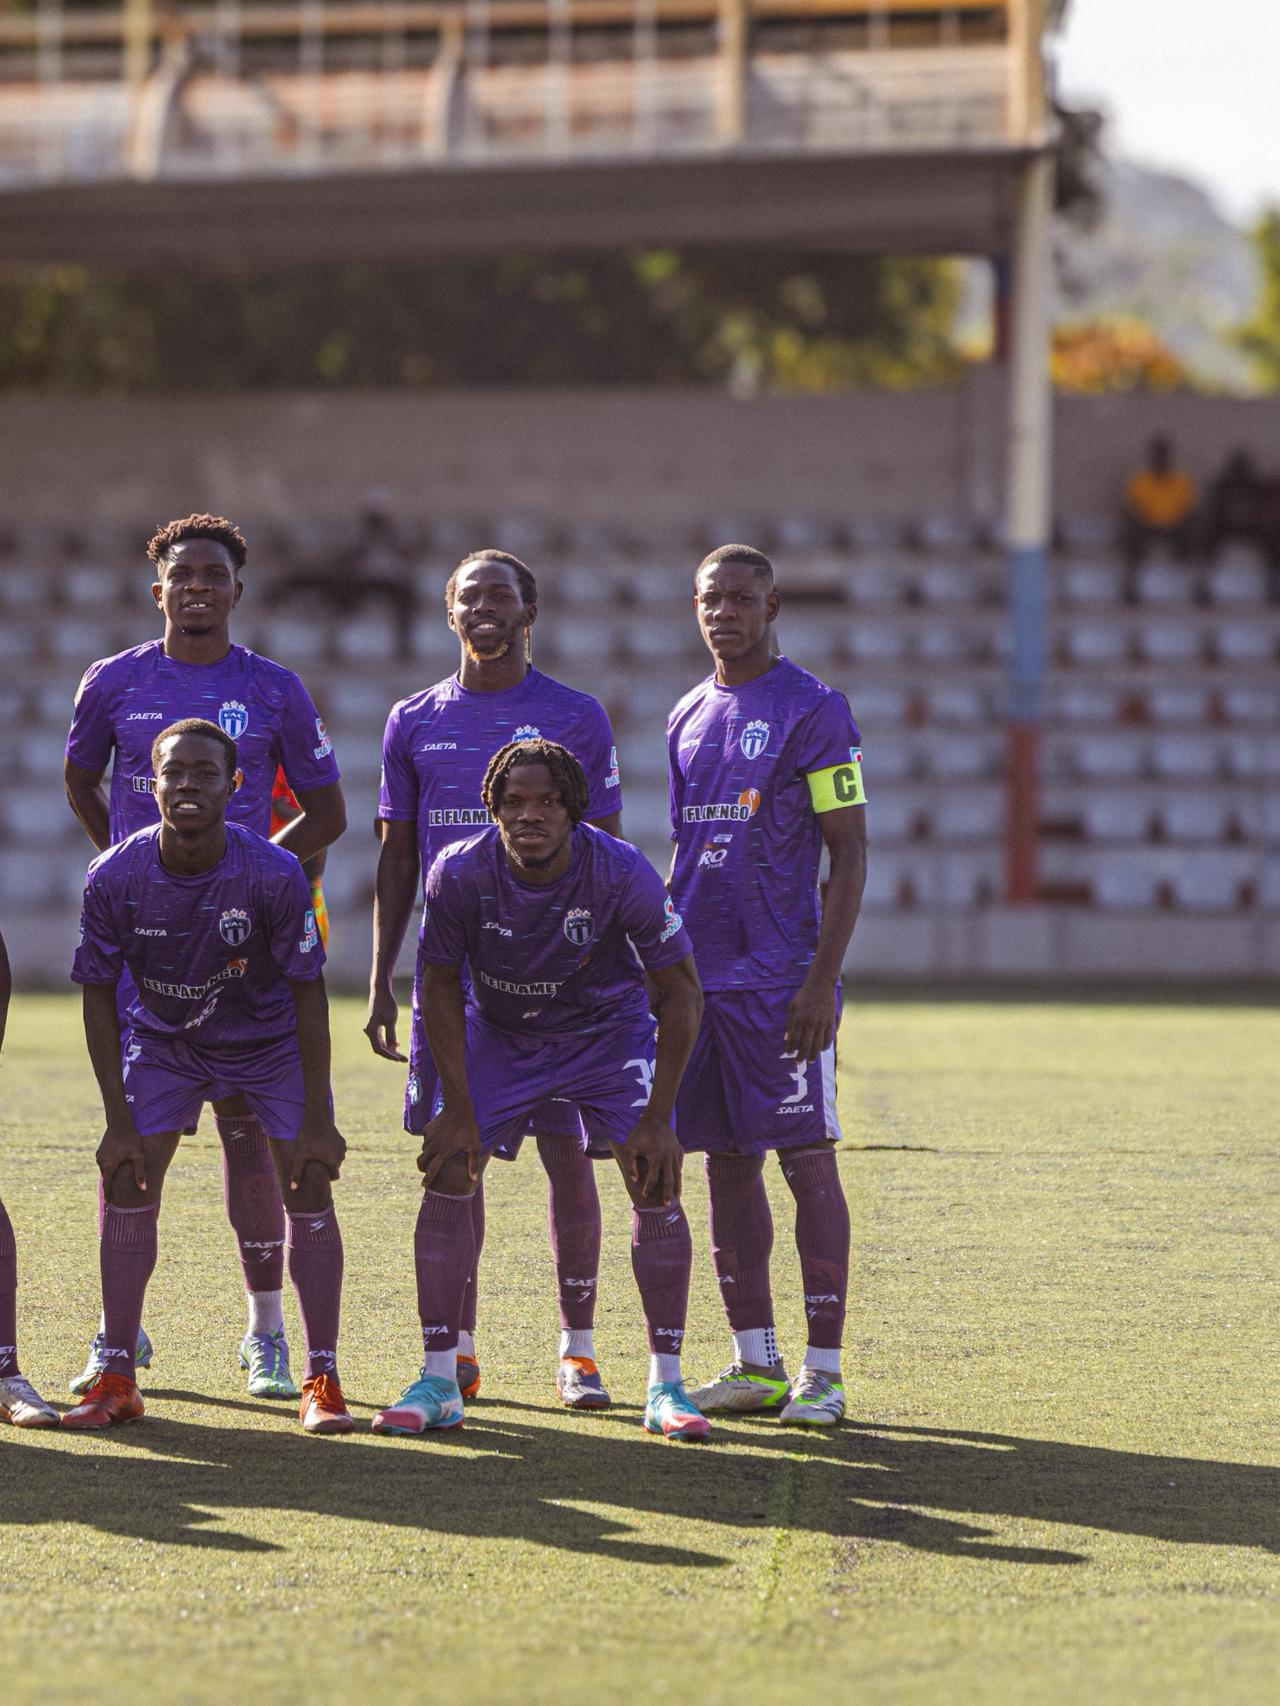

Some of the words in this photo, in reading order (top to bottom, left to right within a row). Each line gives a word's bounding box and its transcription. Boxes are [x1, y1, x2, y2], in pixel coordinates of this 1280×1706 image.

[126, 712, 163, 721] SAETA
[421, 742, 457, 752] SAETA
[132, 776, 147, 793] LE
[832, 767, 858, 802] C
[428, 809, 443, 826] LE
[444, 809, 496, 826] FLAM
[697, 849, 728, 867] RO
[482, 921, 513, 937] SATA
[622, 1058, 657, 1108] 3
[776, 1105, 814, 1115] SAETA
[423, 1326, 449, 1336] ETA
[104, 1348, 129, 1359] ETA
